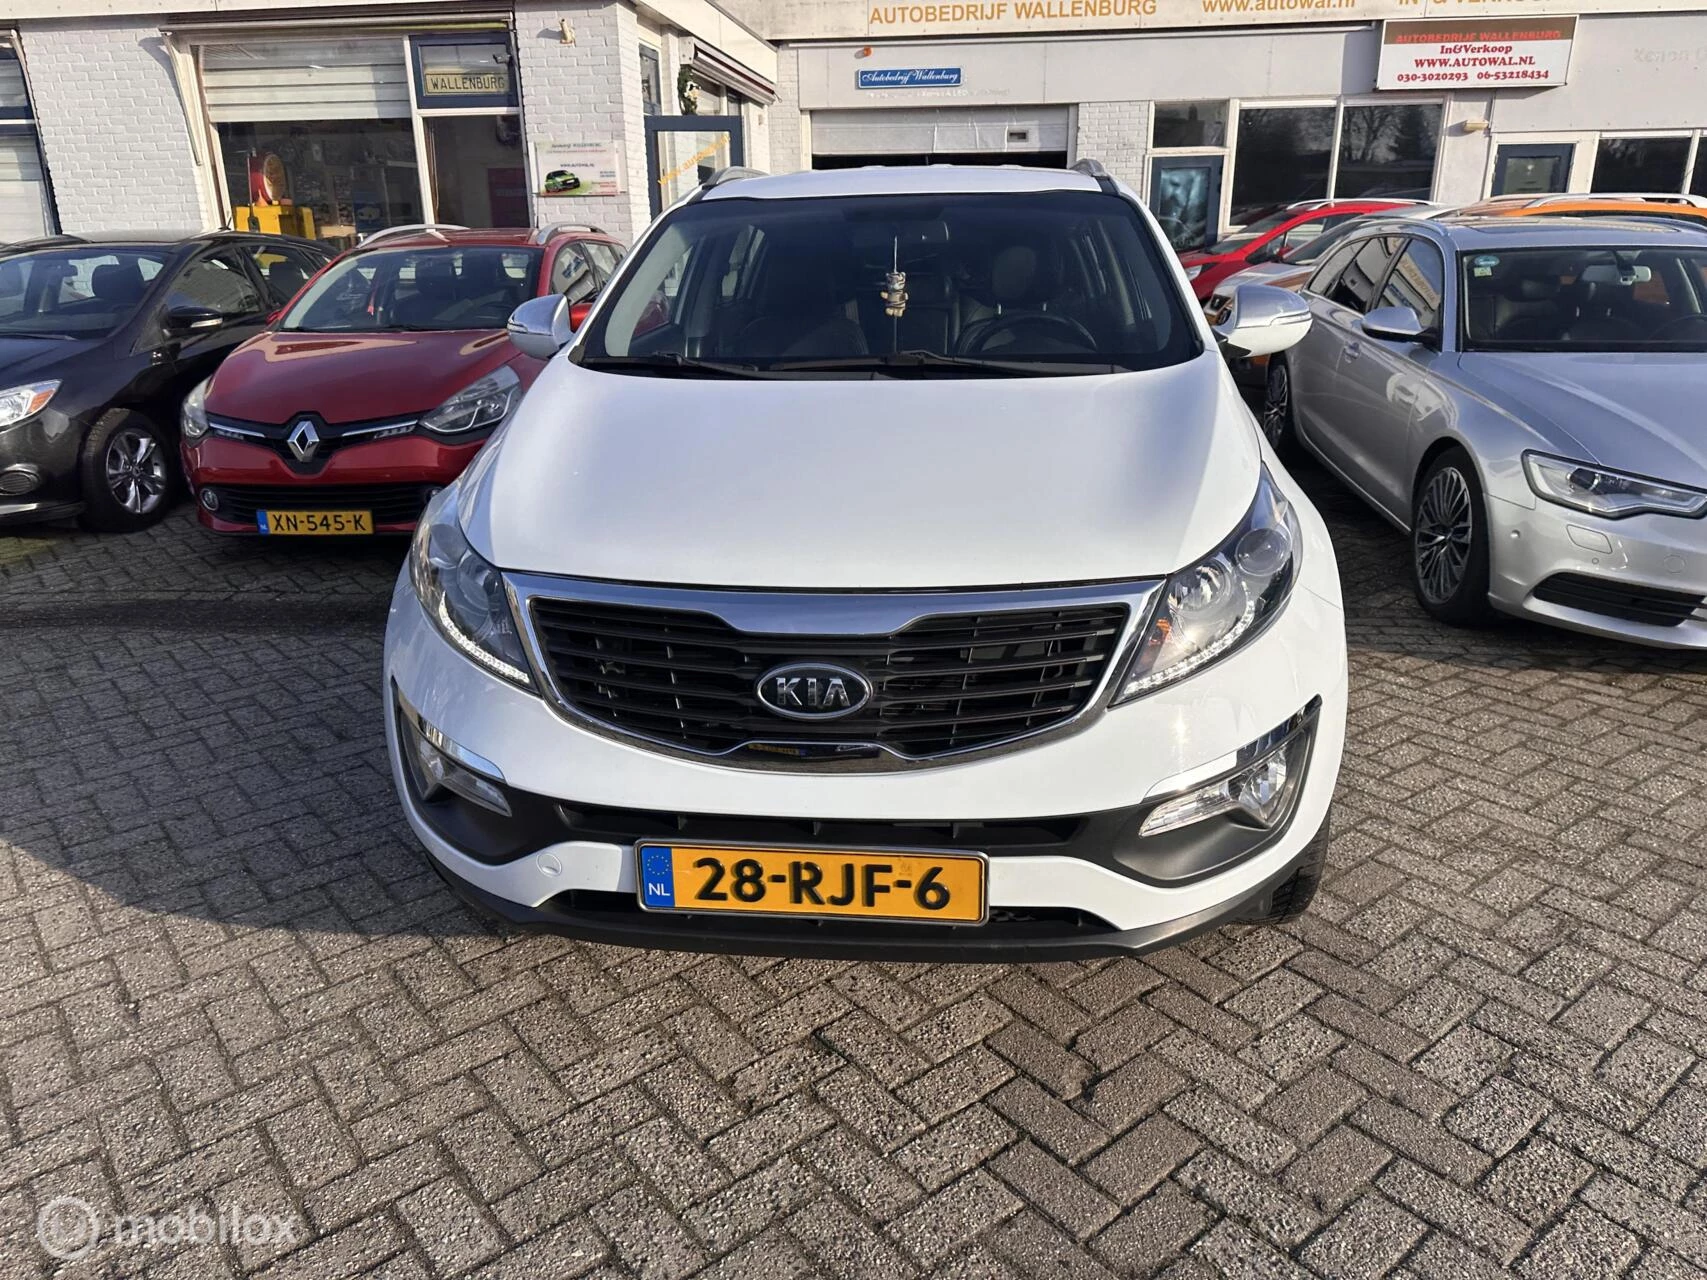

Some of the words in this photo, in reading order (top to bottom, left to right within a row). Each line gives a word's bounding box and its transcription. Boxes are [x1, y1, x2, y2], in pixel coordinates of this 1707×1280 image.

[870, 3, 1008, 24] AUTOBEDRIJF
[1015, 0, 1157, 19] WALLENBURG
[1395, 31, 1476, 43] AUTOBEDRIJF
[1480, 30, 1562, 41] WALLENBURG
[1440, 44, 1513, 54] In&Verkoop
[1414, 56, 1536, 68] WWW.AUTOWAL.NL
[911, 69, 959, 83] Wallenburg
[1397, 71, 1469, 82] 030-3020293
[1477, 69, 1549, 80] 06-53218434
[430, 76, 505, 91] WALLENBURG
[272, 514, 366, 531] XN-545-K
[775, 677, 851, 707] KIA
[648, 882, 671, 897] NL
[693, 857, 951, 910] 28-RJF-6
